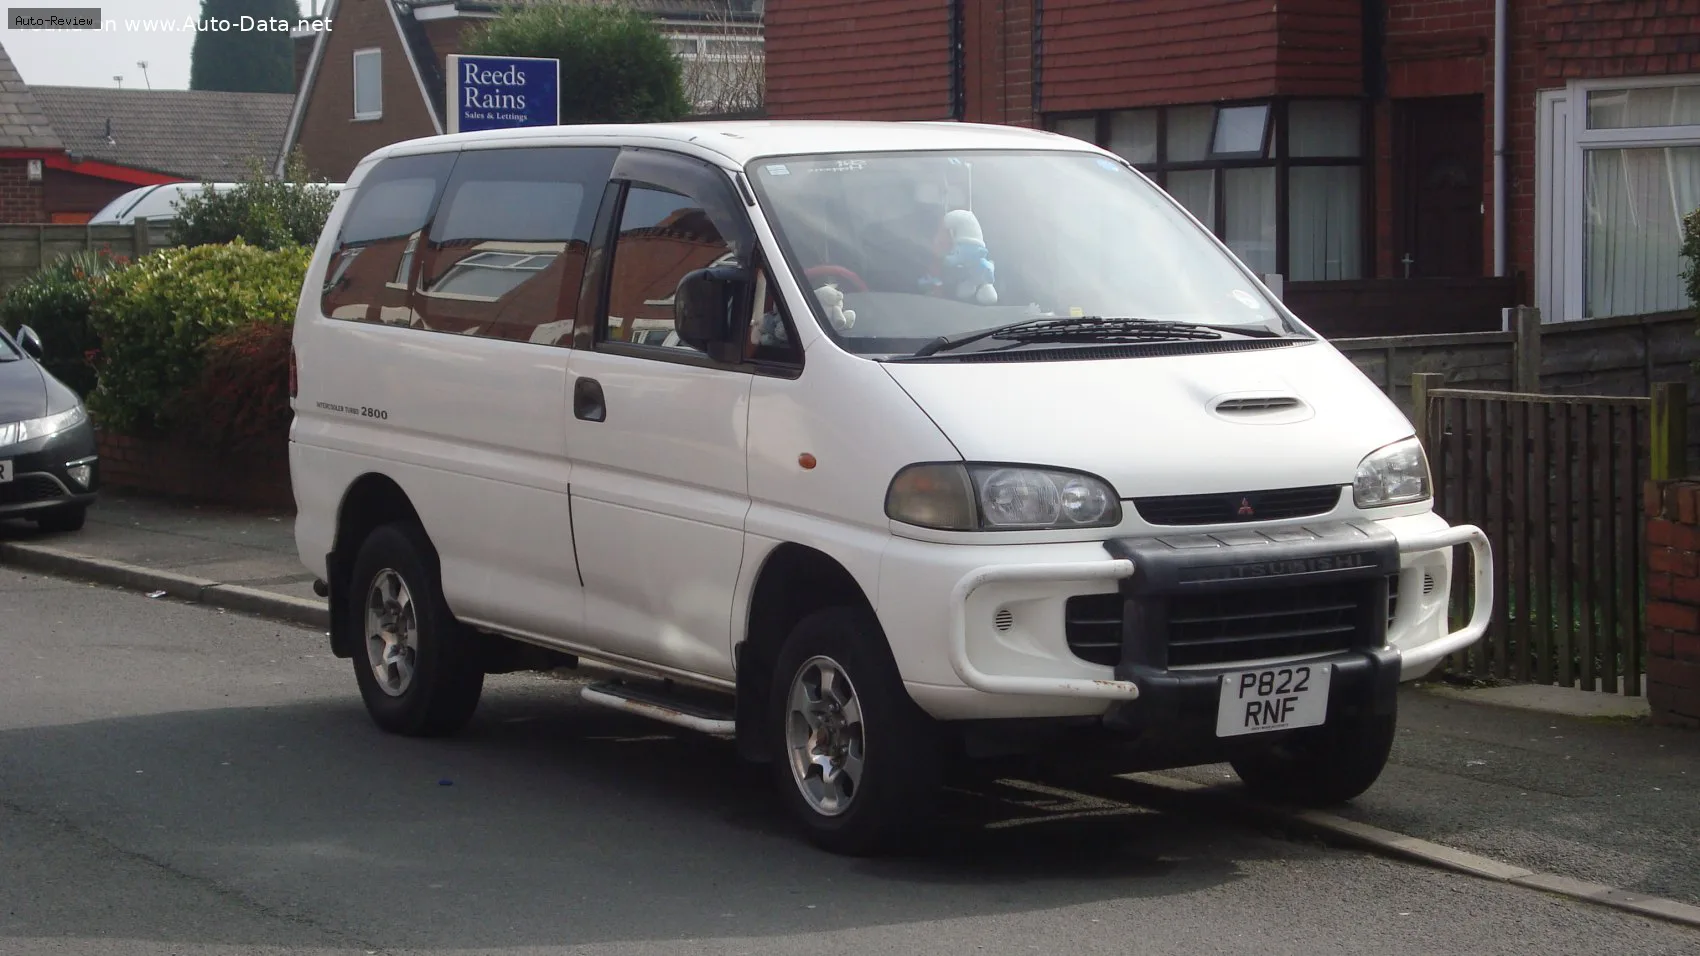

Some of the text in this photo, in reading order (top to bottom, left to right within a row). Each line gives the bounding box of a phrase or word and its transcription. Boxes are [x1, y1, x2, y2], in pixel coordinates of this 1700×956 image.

[464, 63, 526, 86] Reeds
[464, 86, 526, 109] Rains
[464, 111, 485, 119] Sales
[496, 112, 528, 122] Lettings
[361, 406, 388, 420] 2800
[1204, 554, 1363, 578] TSUBISHI
[1239, 667, 1310, 699] P822
[1245, 697, 1298, 727] RNF
